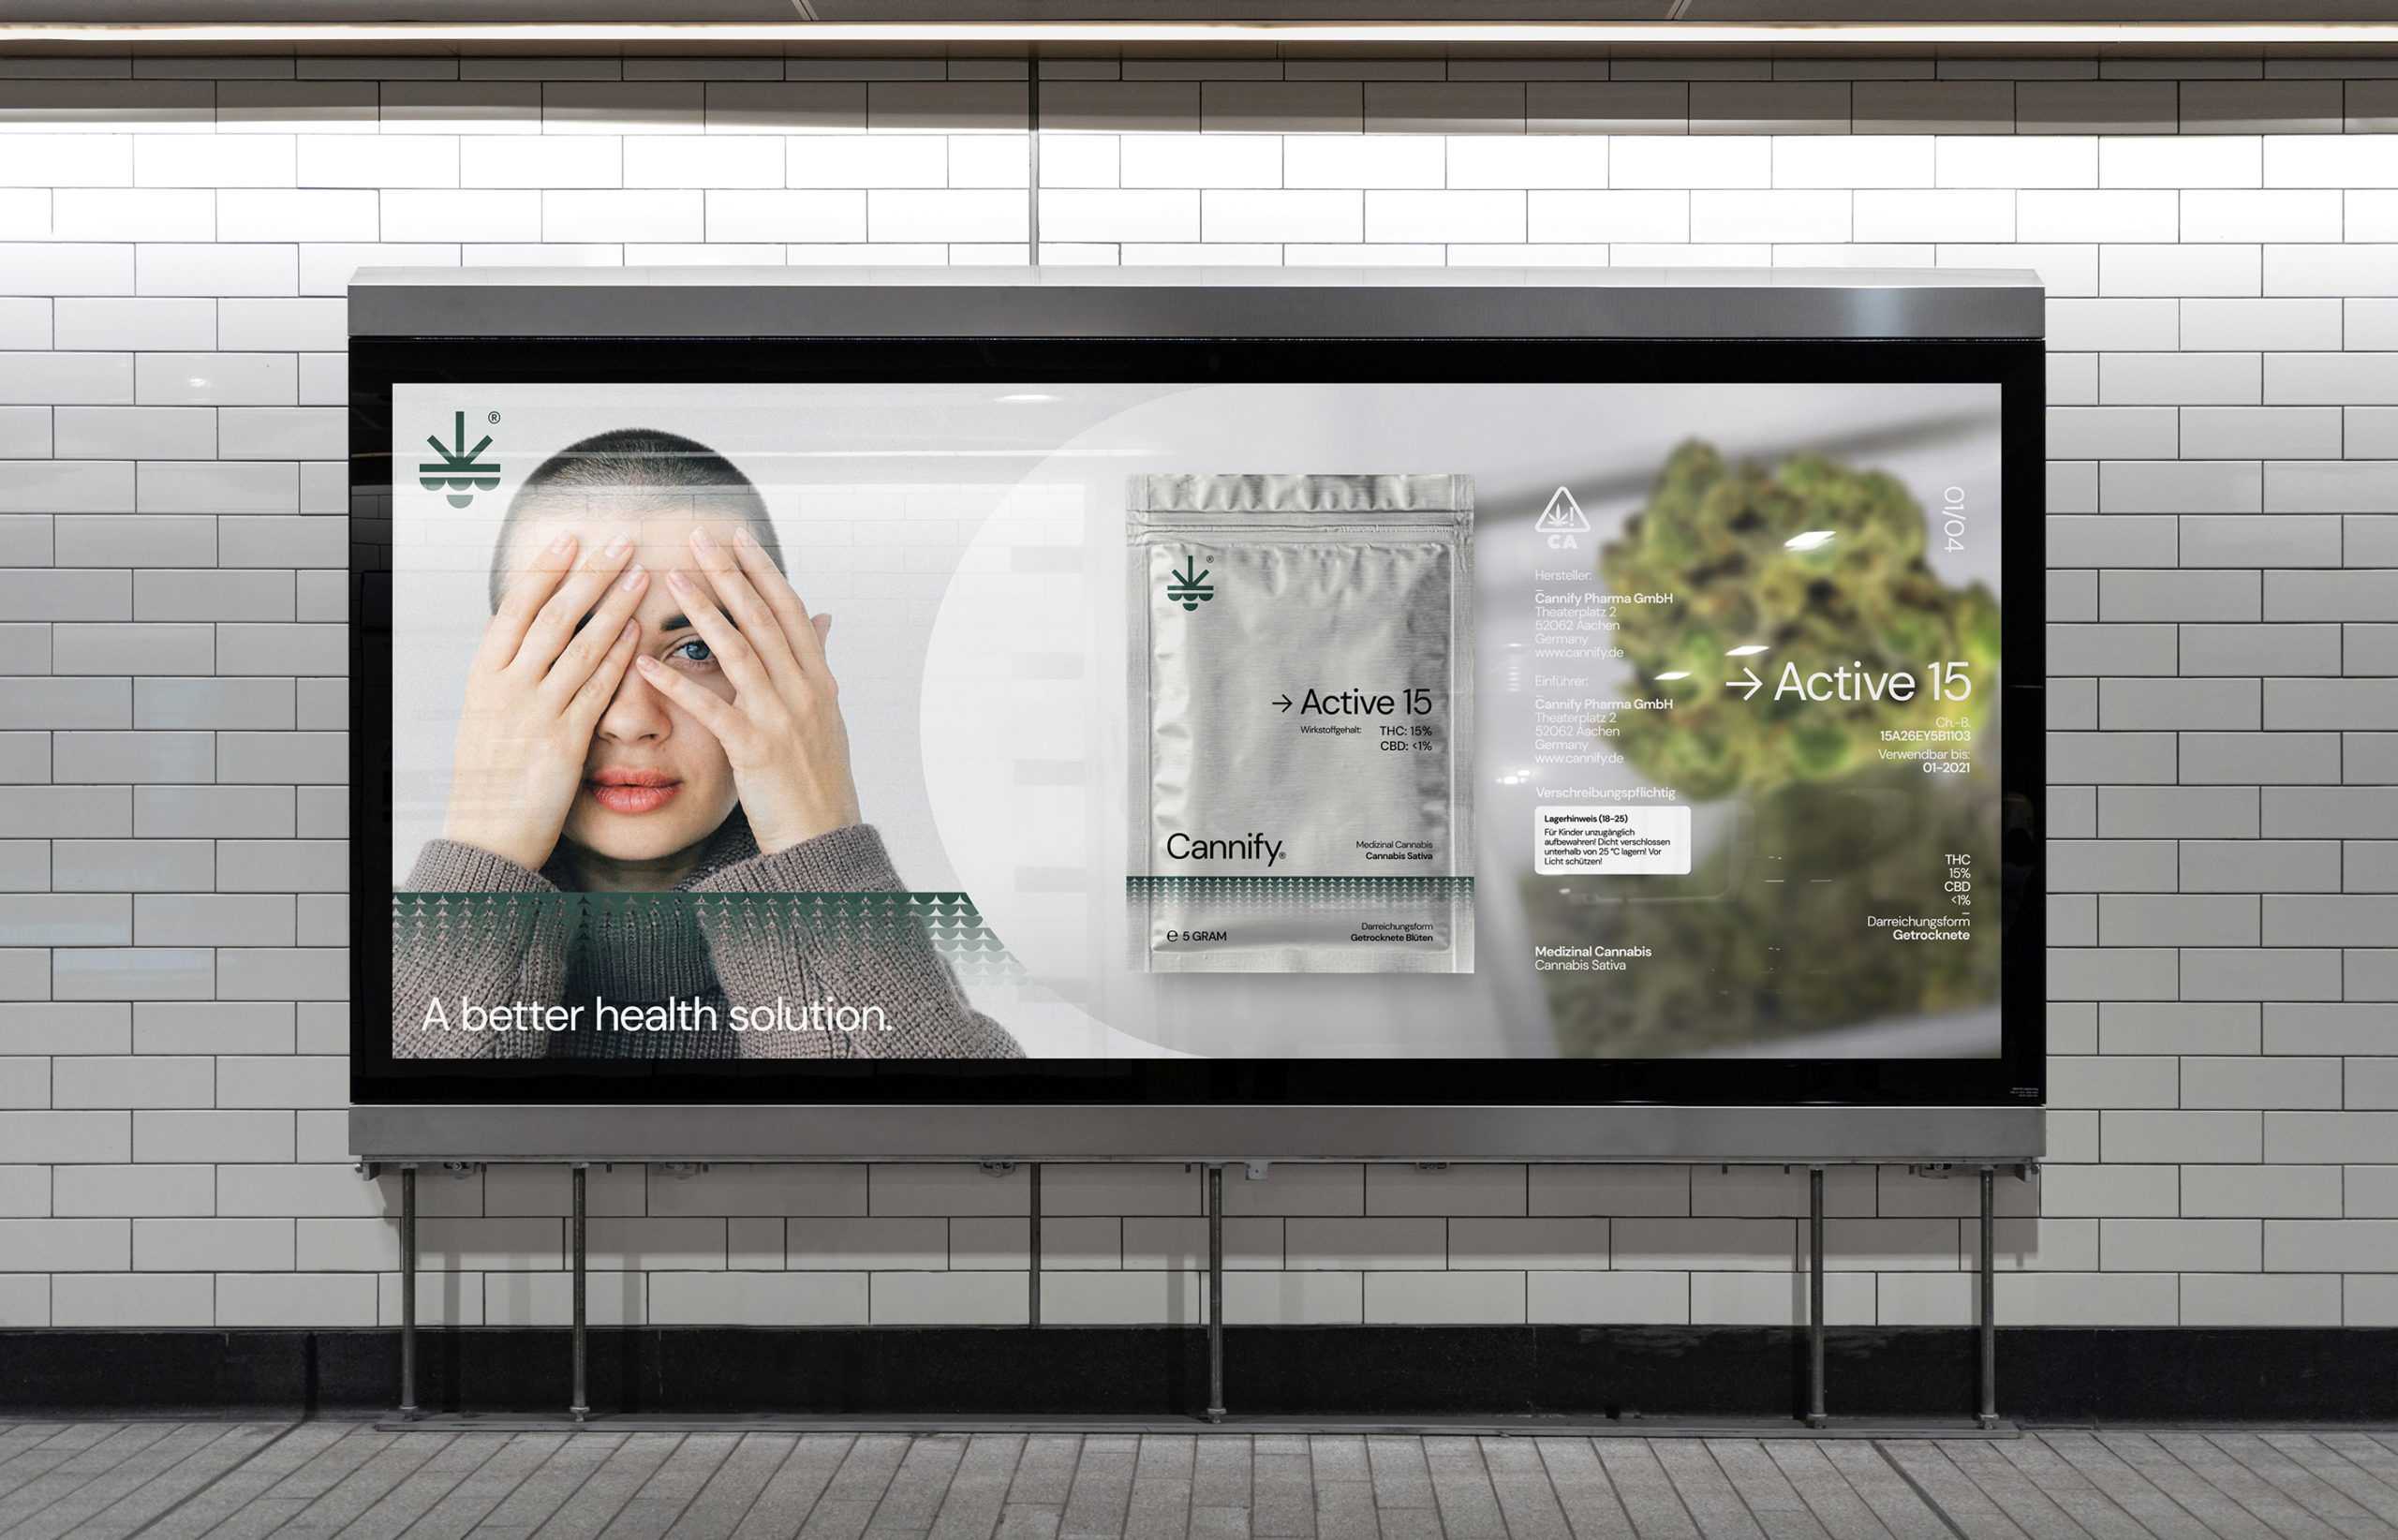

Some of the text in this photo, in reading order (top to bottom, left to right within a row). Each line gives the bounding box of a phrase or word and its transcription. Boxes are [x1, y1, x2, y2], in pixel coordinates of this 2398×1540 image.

[1942, 486, 1966, 553] 01/04
[1547, 534, 1577, 549] CA
[1534, 570, 1592, 581] Hersteller:
[1534, 593, 1674, 606] Cannify Pharma GmbH
[1534, 606, 1617, 619] Theaterplatz 2
[1535, 620, 1621, 630] 52062 Aachen
[1534, 633, 1589, 646] Germany
[1534, 646, 1624, 659] www.cannify.de
[1534, 675, 1590, 687] Einführer:
[1773, 660, 1972, 702] Active 15
[1300, 688, 1433, 716] Active 15
[1534, 699, 1674, 712] Cannify Pharma GmbH
[1534, 712, 1617, 725] Theaterplatz 2
[1300, 725, 1433, 736] Wirkstoffgehalt: THC: 15%
[1535, 726, 1621, 736] 52062 Aachen
[1380, 741, 1433, 751] CBD: <1%
[1534, 740, 1589, 752] Germany
[1534, 752, 1624, 765] www.cannify.de
[1878, 748, 1971, 760] Verwendbar bis:
[1923, 763, 1971, 774] 01-2021
[1535, 787, 1676, 801] Verschreibungspflichtig
[1544, 814, 1629, 824] Lagerhinweis (18-25)
[1544, 828, 1636, 838] Für Kinder unzugänglich
[1355, 840, 1433, 849] Medizinal Cannabis
[1544, 837, 1671, 847] aufbewahren! Dicht verschlossen
[1366, 851, 1433, 861] Cannabis Sativa
[1544, 848, 1582, 856] unterhalb
[1599, 848, 1609, 856] 25
[1621, 848, 1647, 857] lagern!
[1648, 848, 1662, 856] Vor
[1544, 857, 1603, 866] Licht schützen!
[1945, 854, 1971, 866] THC
[1949, 867, 1971, 879] 15%
[1944, 881, 1971, 892] CBD
[1951, 895, 1971, 906] <1%
[1361, 922, 1433, 933] Darreichungsform
[1867, 915, 1971, 930] Darreichungsform
[1182, 931, 1191, 941] 5
[1192, 931, 1227, 941] GRAM
[1350, 933, 1433, 942] Getrocknete Blüten
[1892, 929, 1971, 940] Getrocknete
[1534, 946, 1652, 957] Medizinal Cannabis
[1534, 959, 1627, 970] Cannabis Sativa
[422, 996, 893, 1032] A better health solution.
